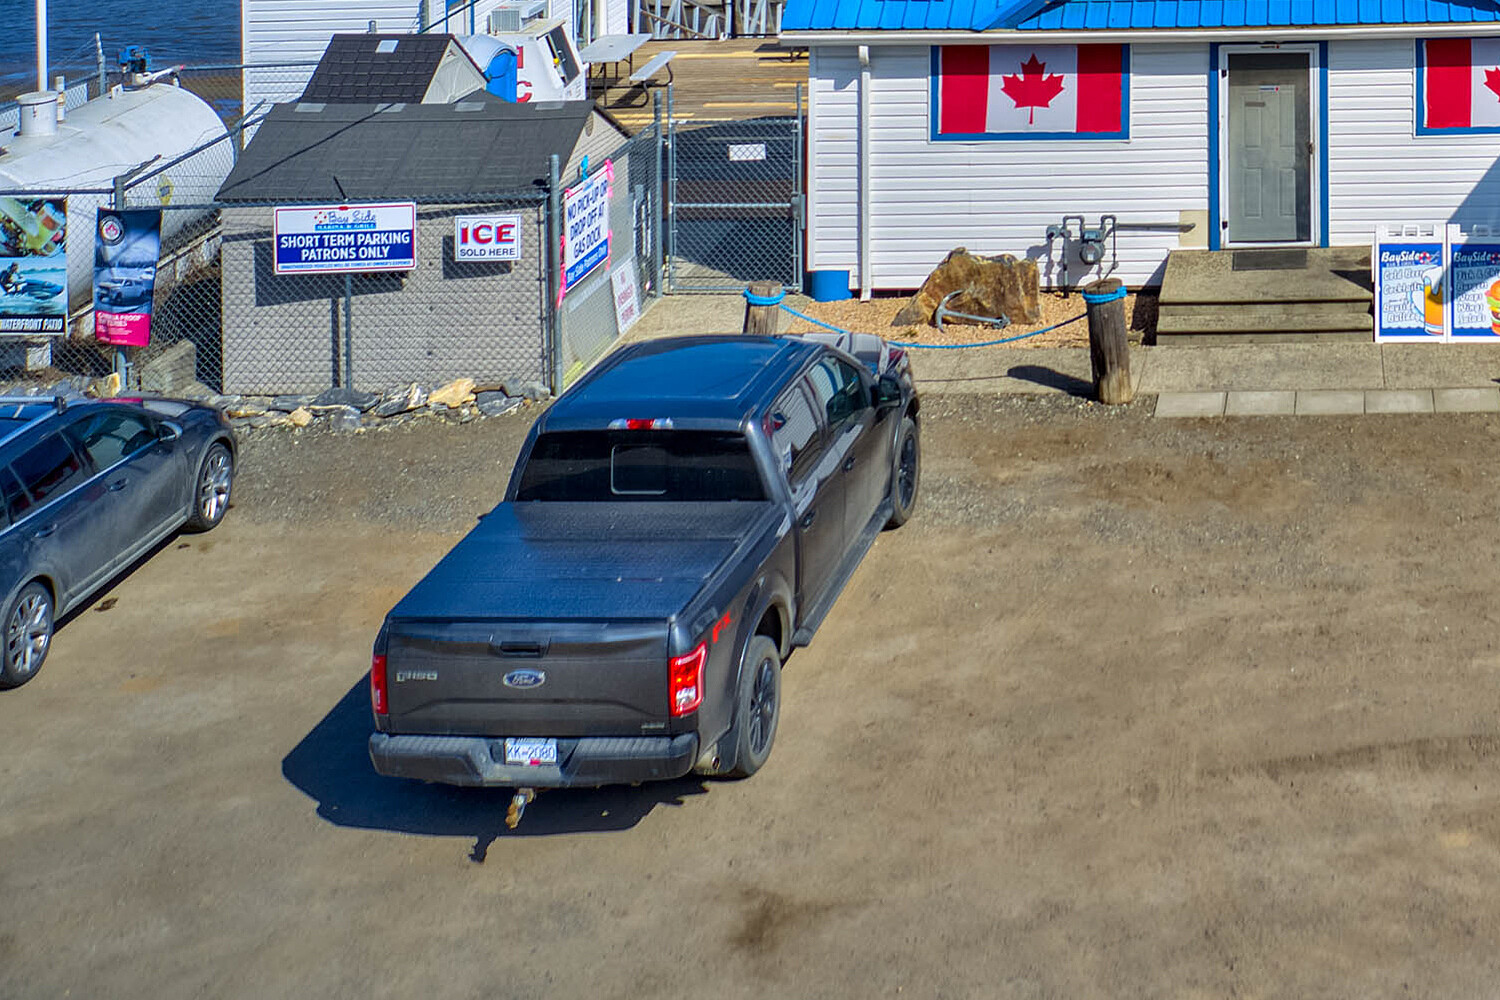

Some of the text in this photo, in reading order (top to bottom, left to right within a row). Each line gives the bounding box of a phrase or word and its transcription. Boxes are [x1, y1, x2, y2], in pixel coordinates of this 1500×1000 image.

[567, 202, 576, 222] NO
[577, 186, 599, 215] PICK-UP
[461, 222, 516, 245] ICE
[570, 215, 586, 241] DROP
[587, 207, 597, 228] OFF
[280, 231, 410, 249] SHORT TERM PARKING
[574, 224, 601, 259] GAS DOCK
[301, 245, 390, 262] PATRONS ONLY
[459, 248, 515, 257] SOLD HERE
[42, 318, 63, 330] PATIO
